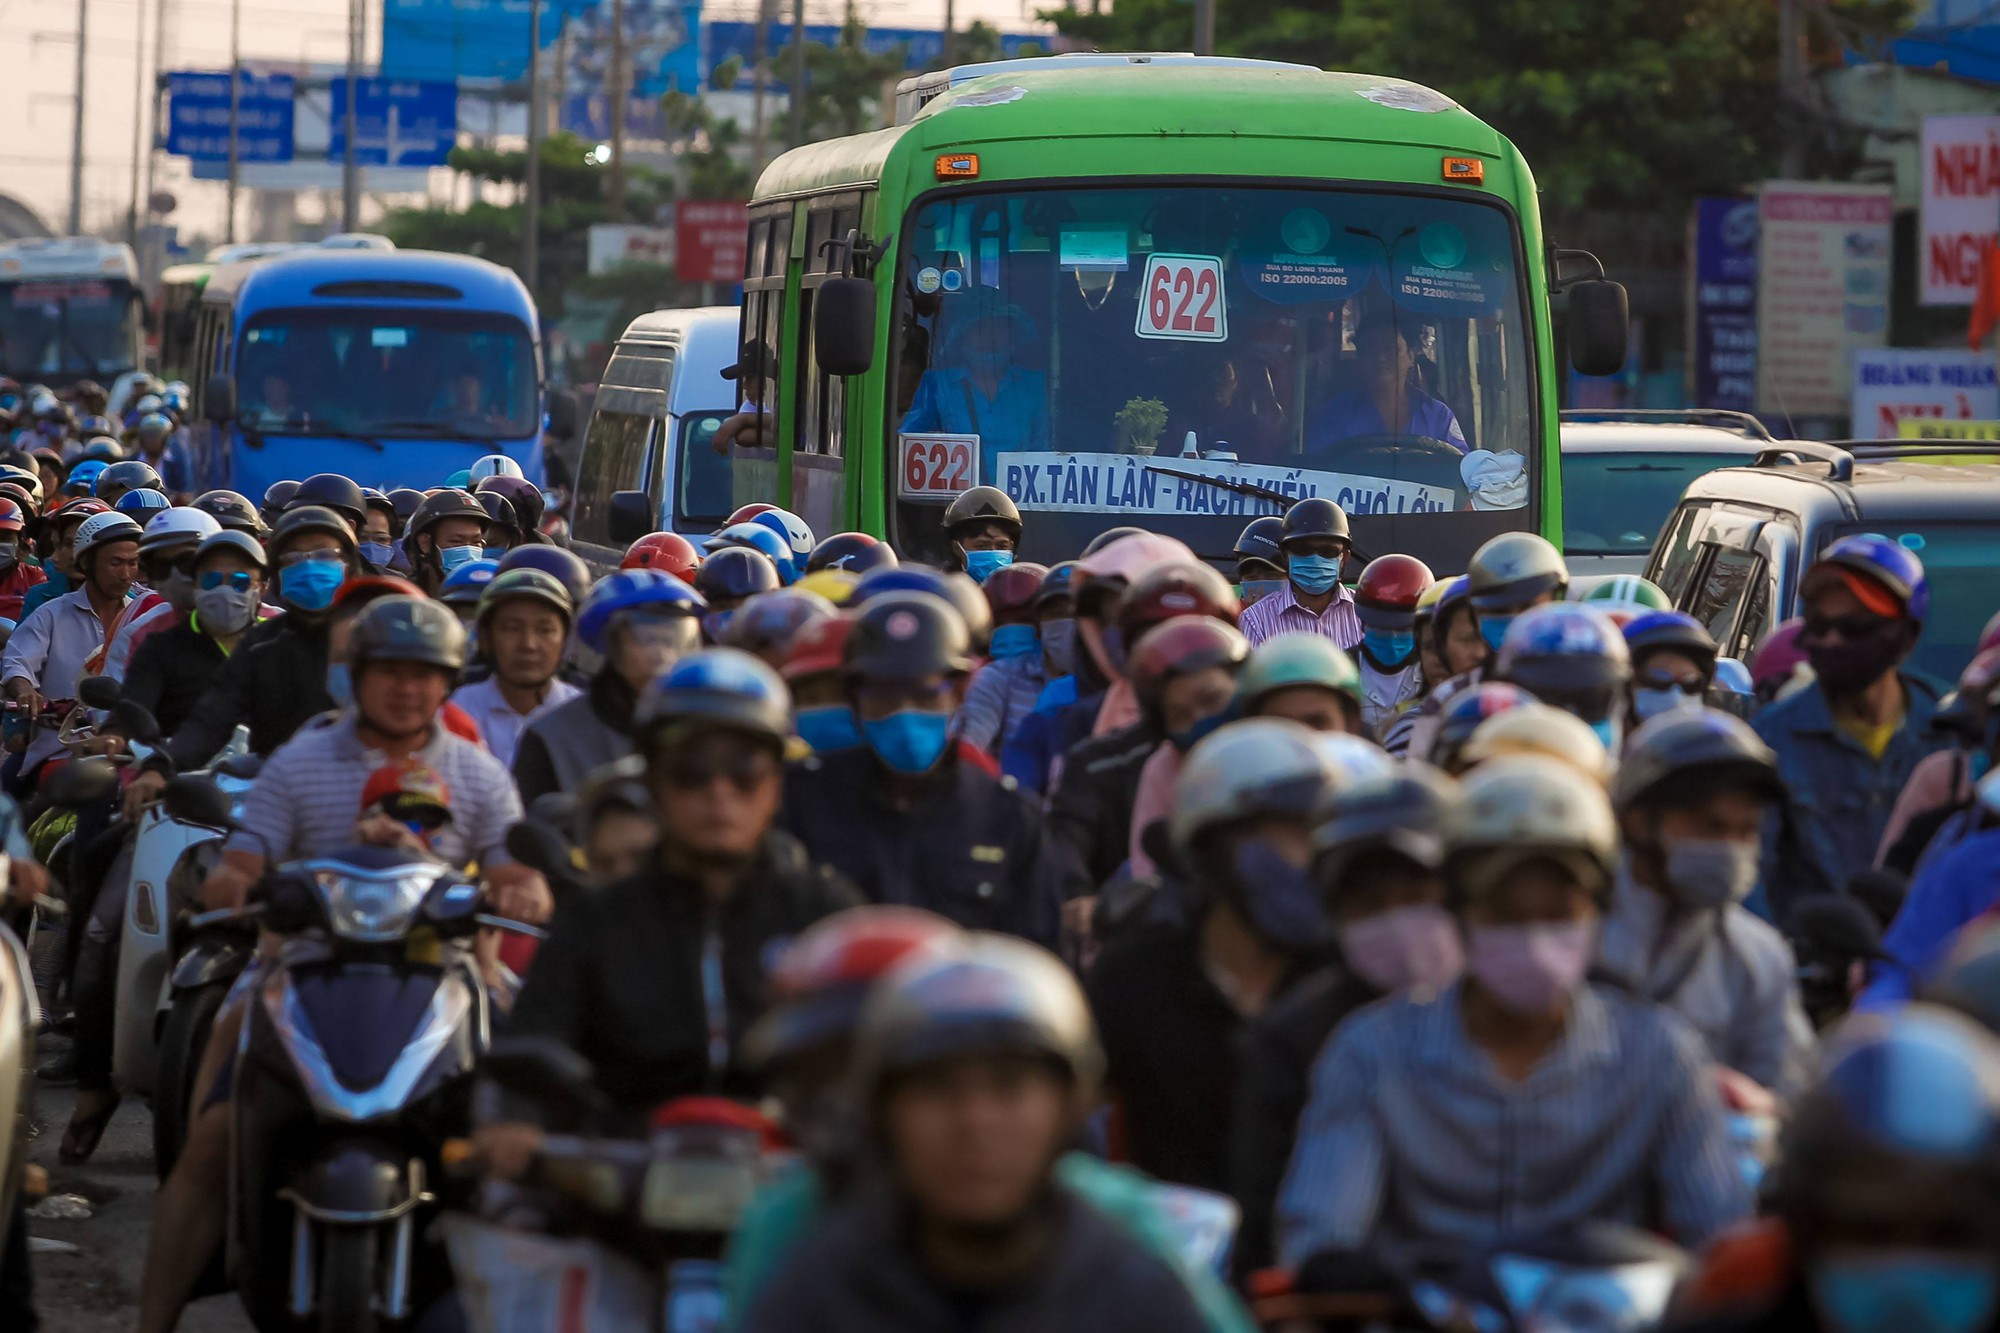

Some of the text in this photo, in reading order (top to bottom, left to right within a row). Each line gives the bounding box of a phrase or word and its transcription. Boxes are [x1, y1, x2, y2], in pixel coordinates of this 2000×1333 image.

[1261, 273, 1349, 286] ISO 22000:2005
[1401, 284, 1420, 295] ISO
[1149, 265, 1217, 333] 622
[906, 442, 970, 491] 622
[1006, 456, 1099, 505] BX.TÂN
[1253, 535, 1279, 548] HONDA
